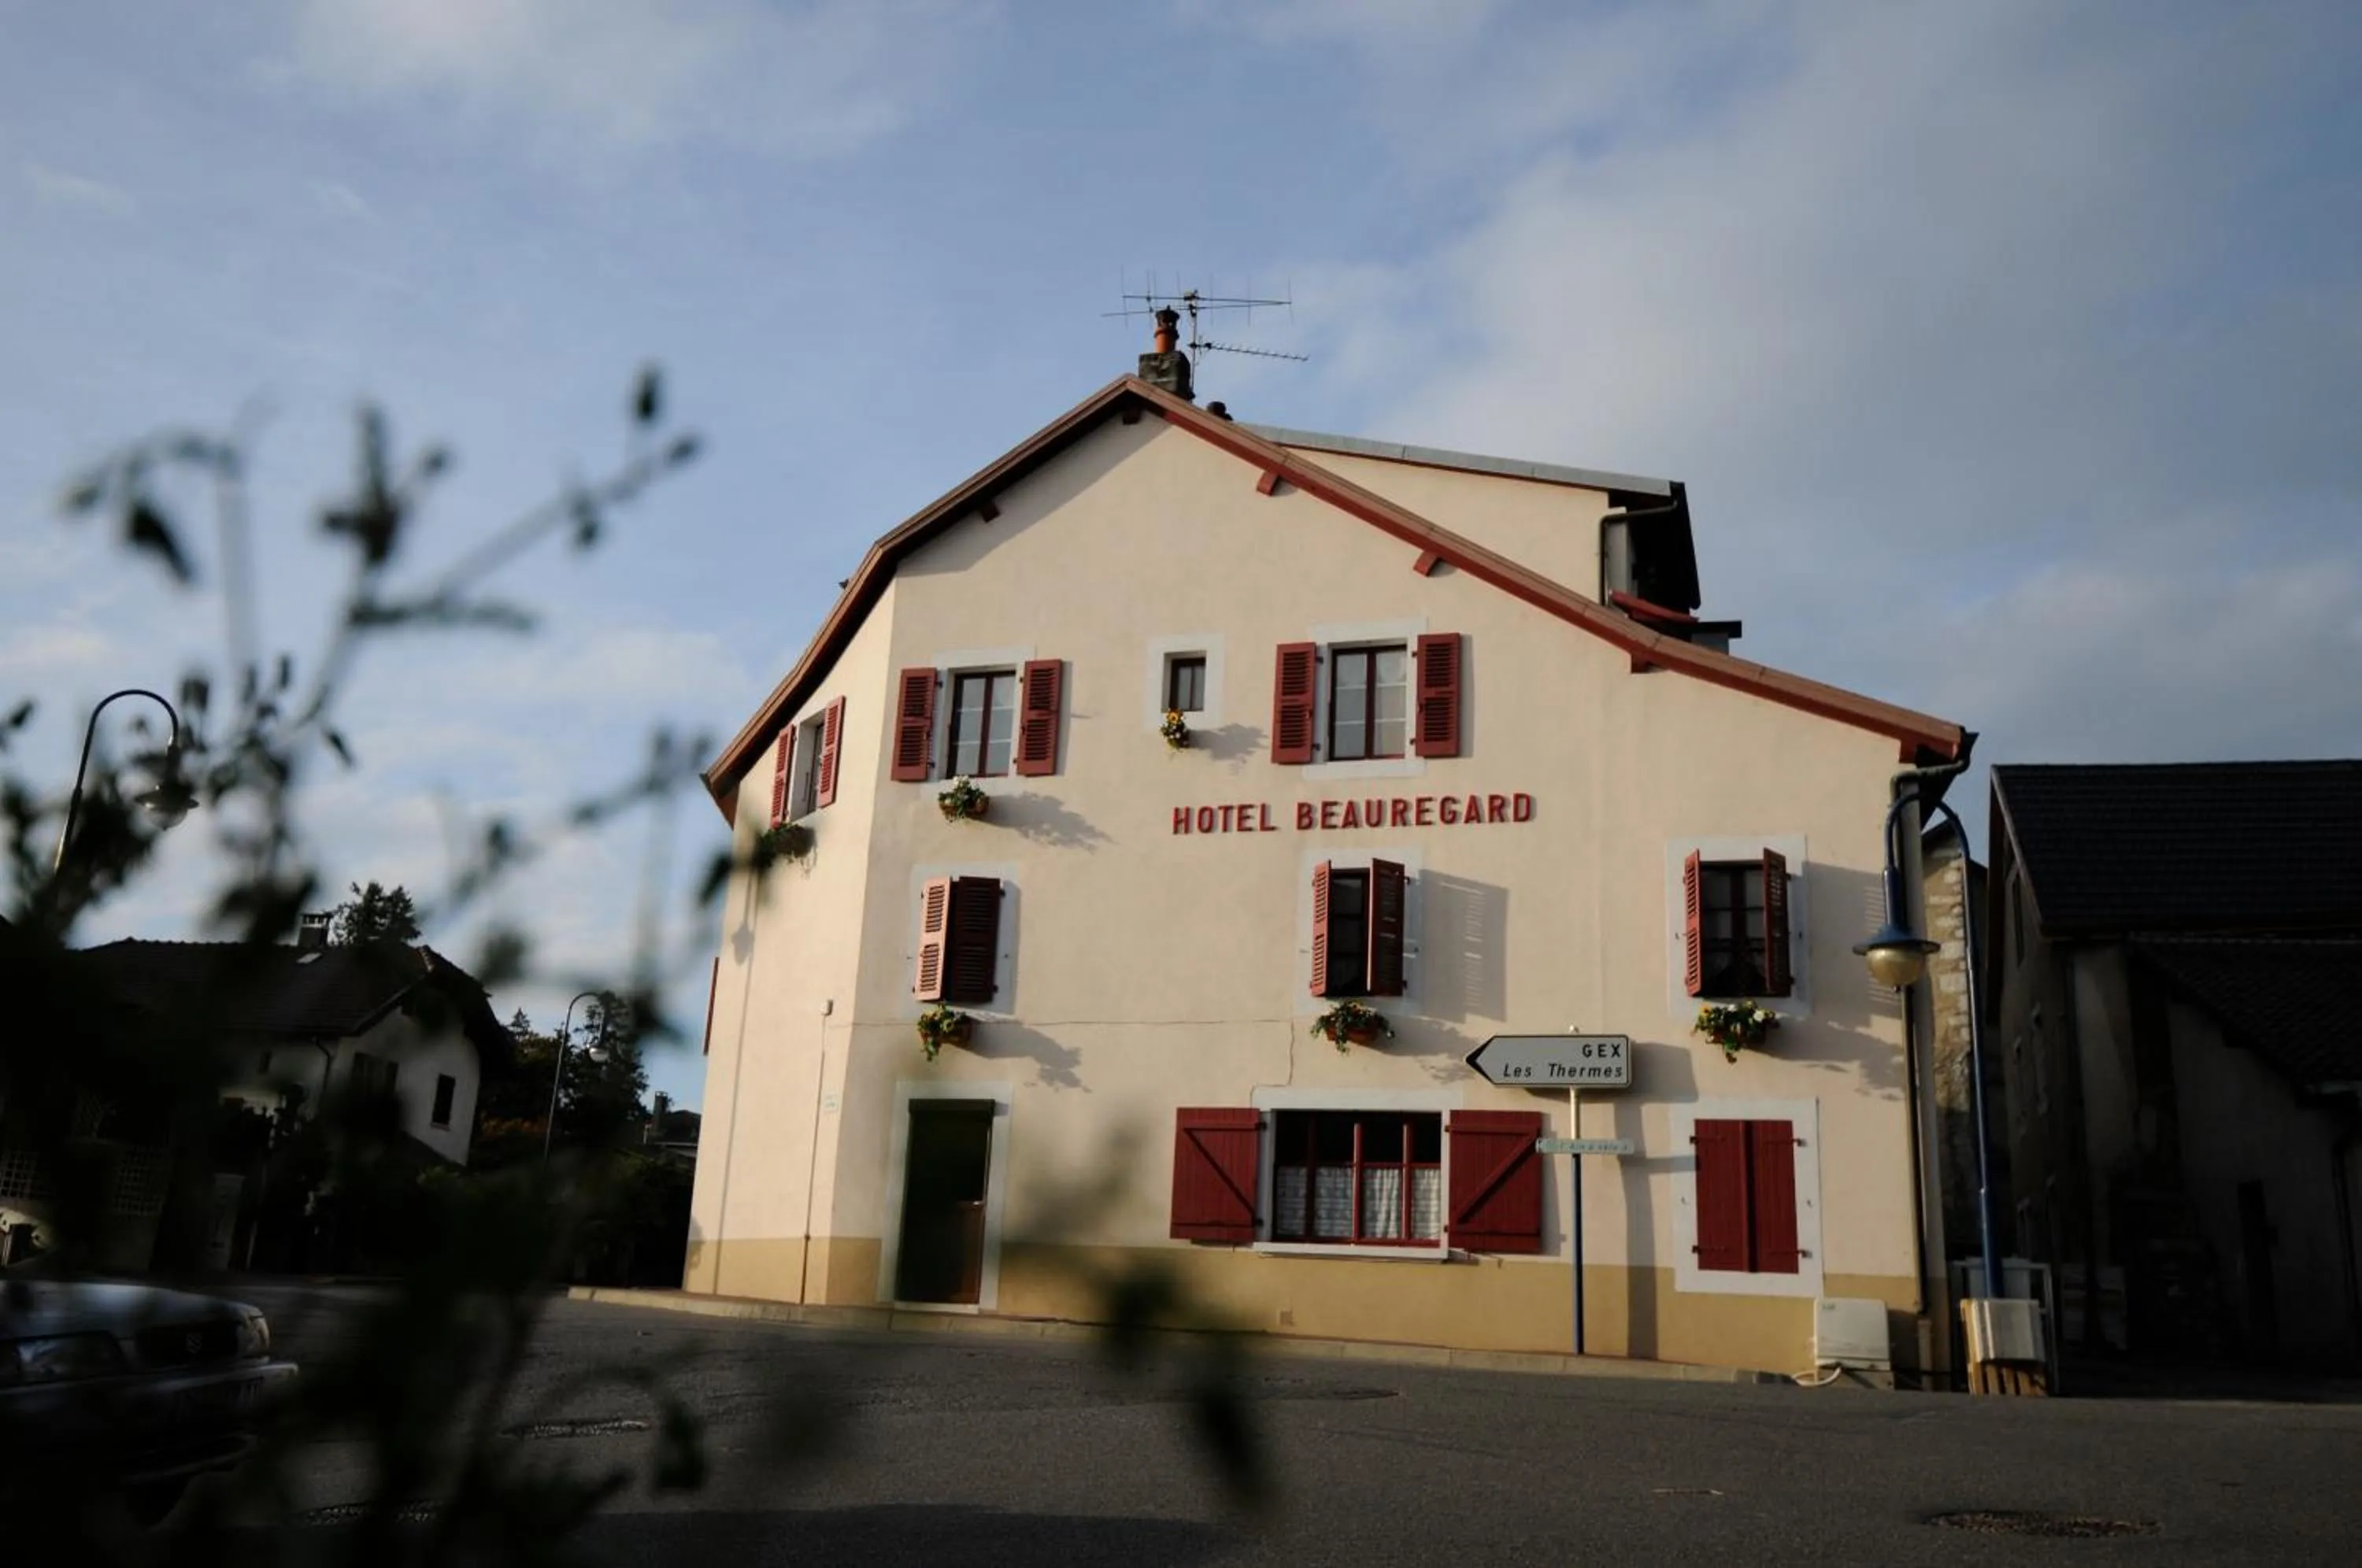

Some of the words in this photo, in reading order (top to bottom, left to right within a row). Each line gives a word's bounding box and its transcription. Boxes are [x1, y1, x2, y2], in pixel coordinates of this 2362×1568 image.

[1172, 803, 1279, 834] HOTEL
[1296, 793, 1535, 830] BEAUREGARD
[1582, 1044, 1621, 1058] GEX
[1503, 1063, 1532, 1078] Les
[1549, 1063, 1623, 1078] Thermes
